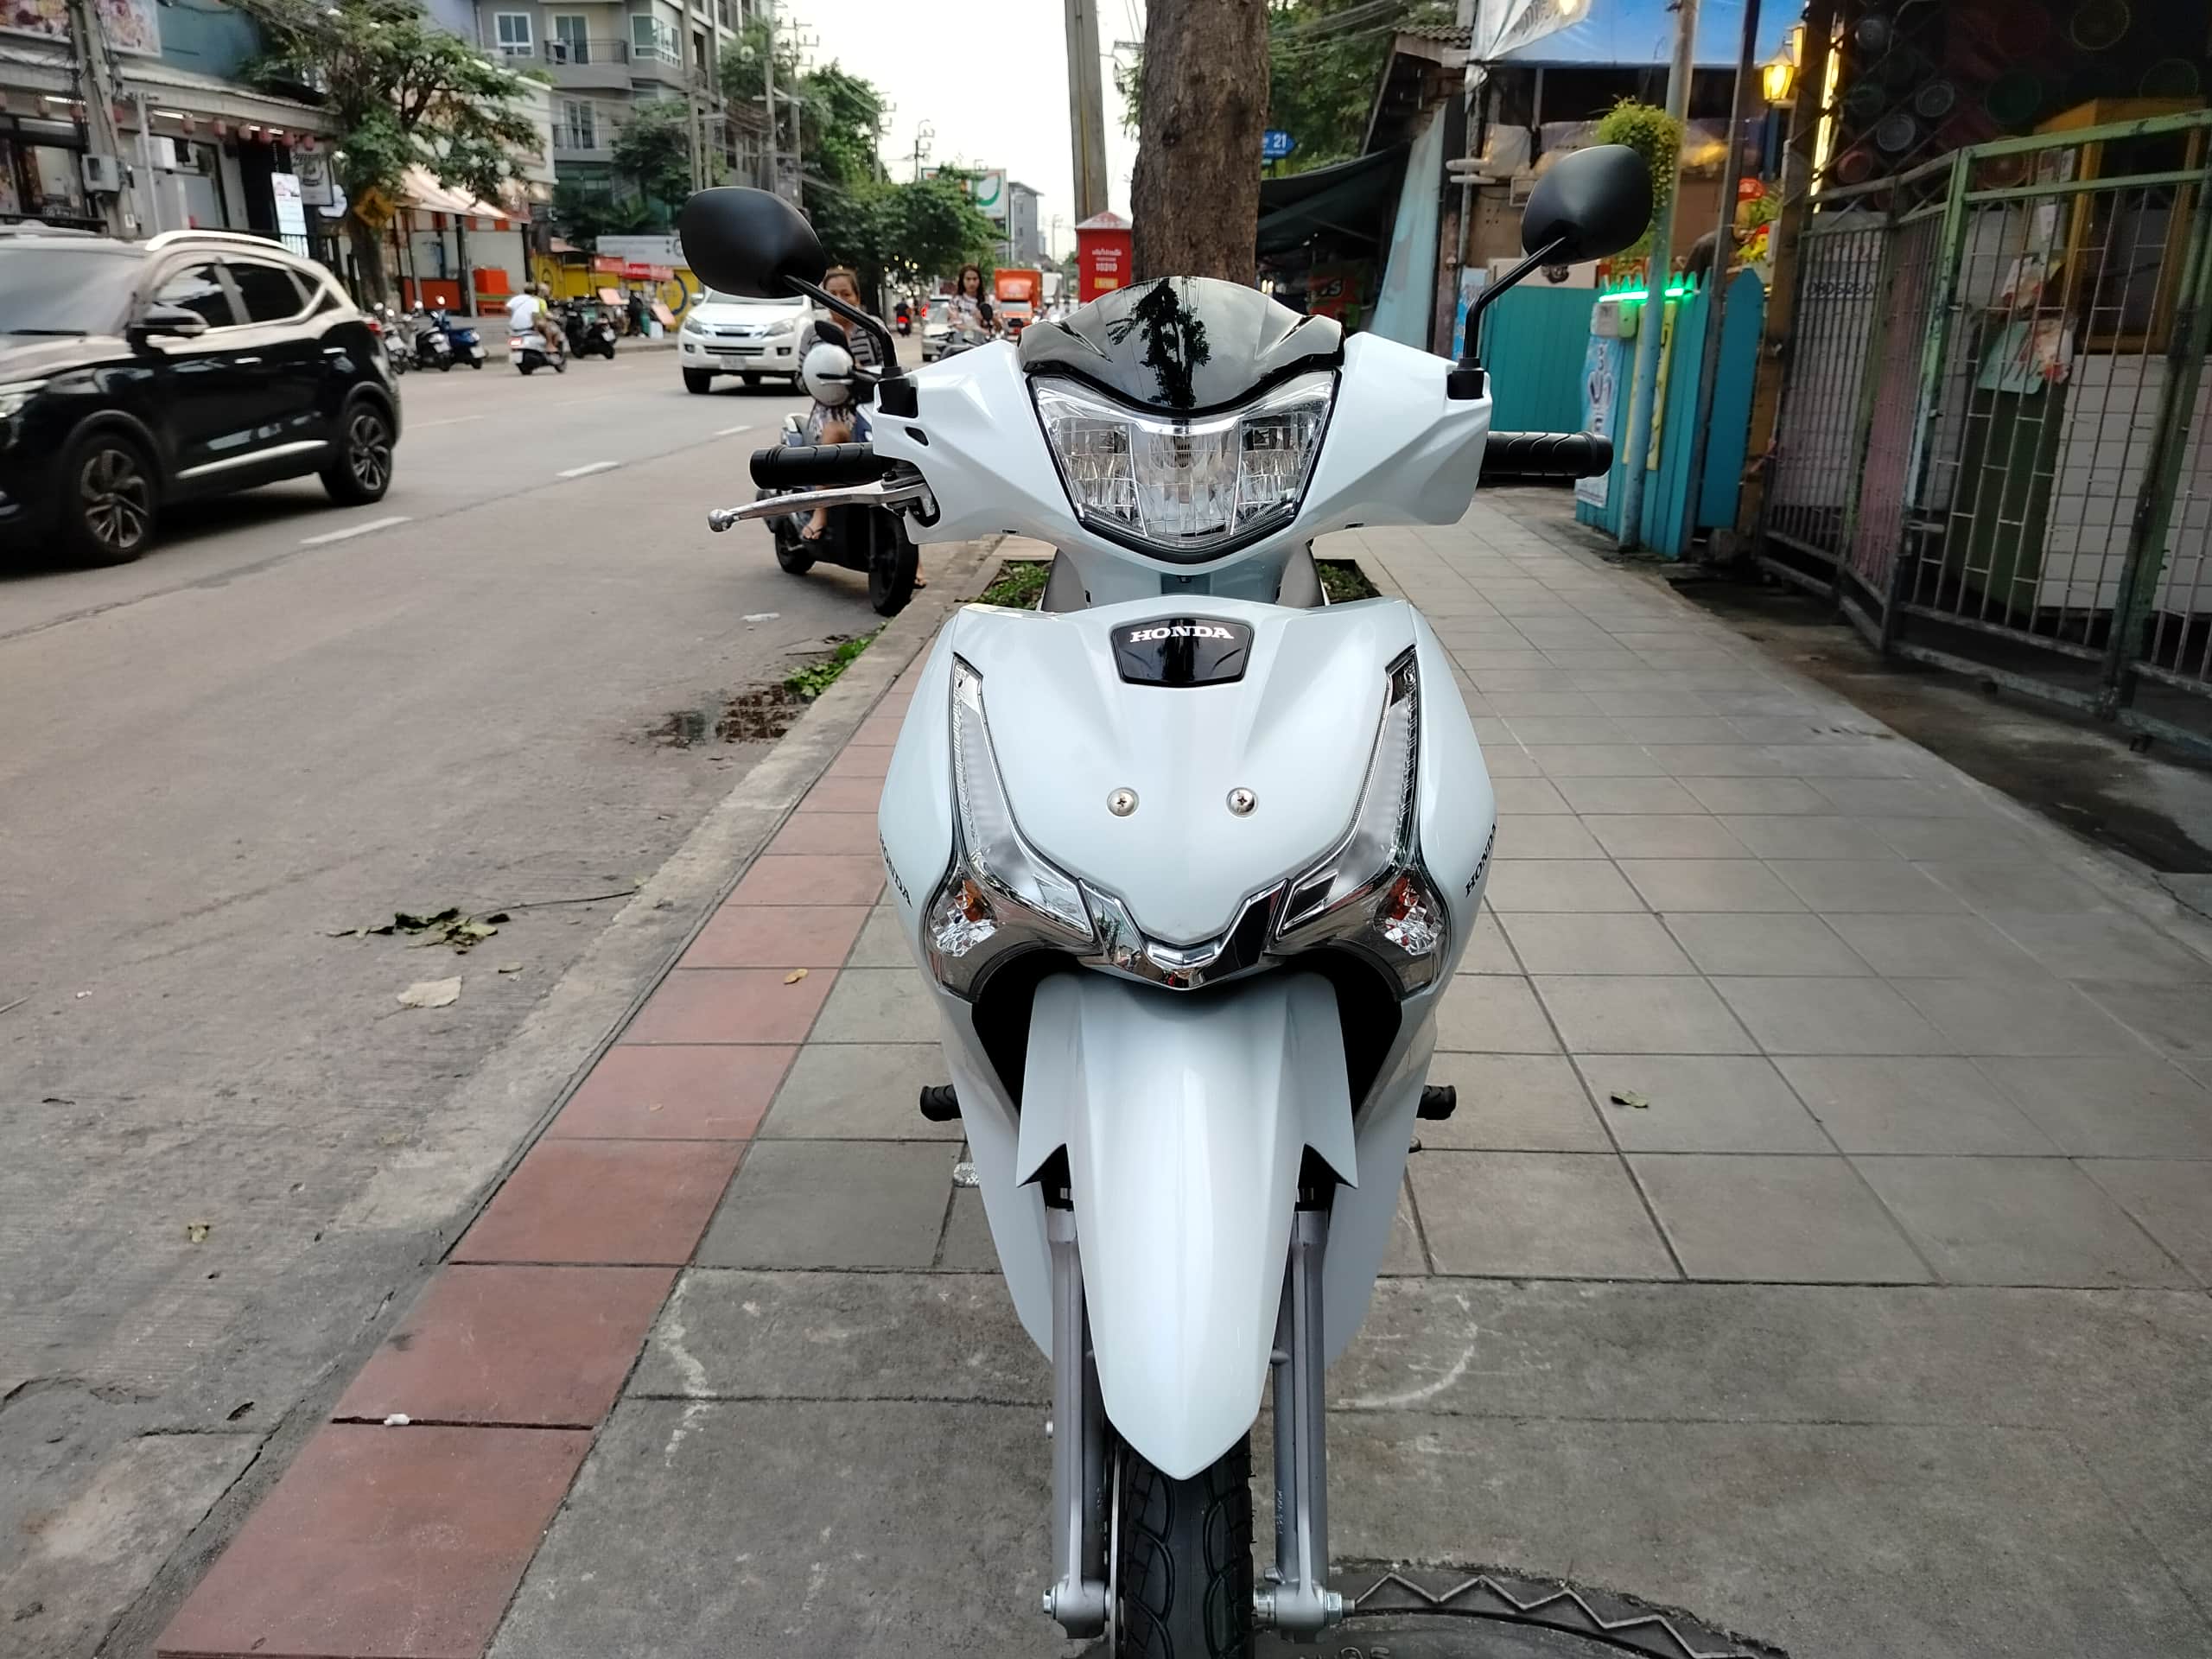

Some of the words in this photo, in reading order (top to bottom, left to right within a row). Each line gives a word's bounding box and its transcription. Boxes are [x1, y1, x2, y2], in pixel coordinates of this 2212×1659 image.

[1274, 134, 1287, 148] 21
[1129, 626, 1235, 643] HONDA
[1465, 823, 1496, 899] HONDA
